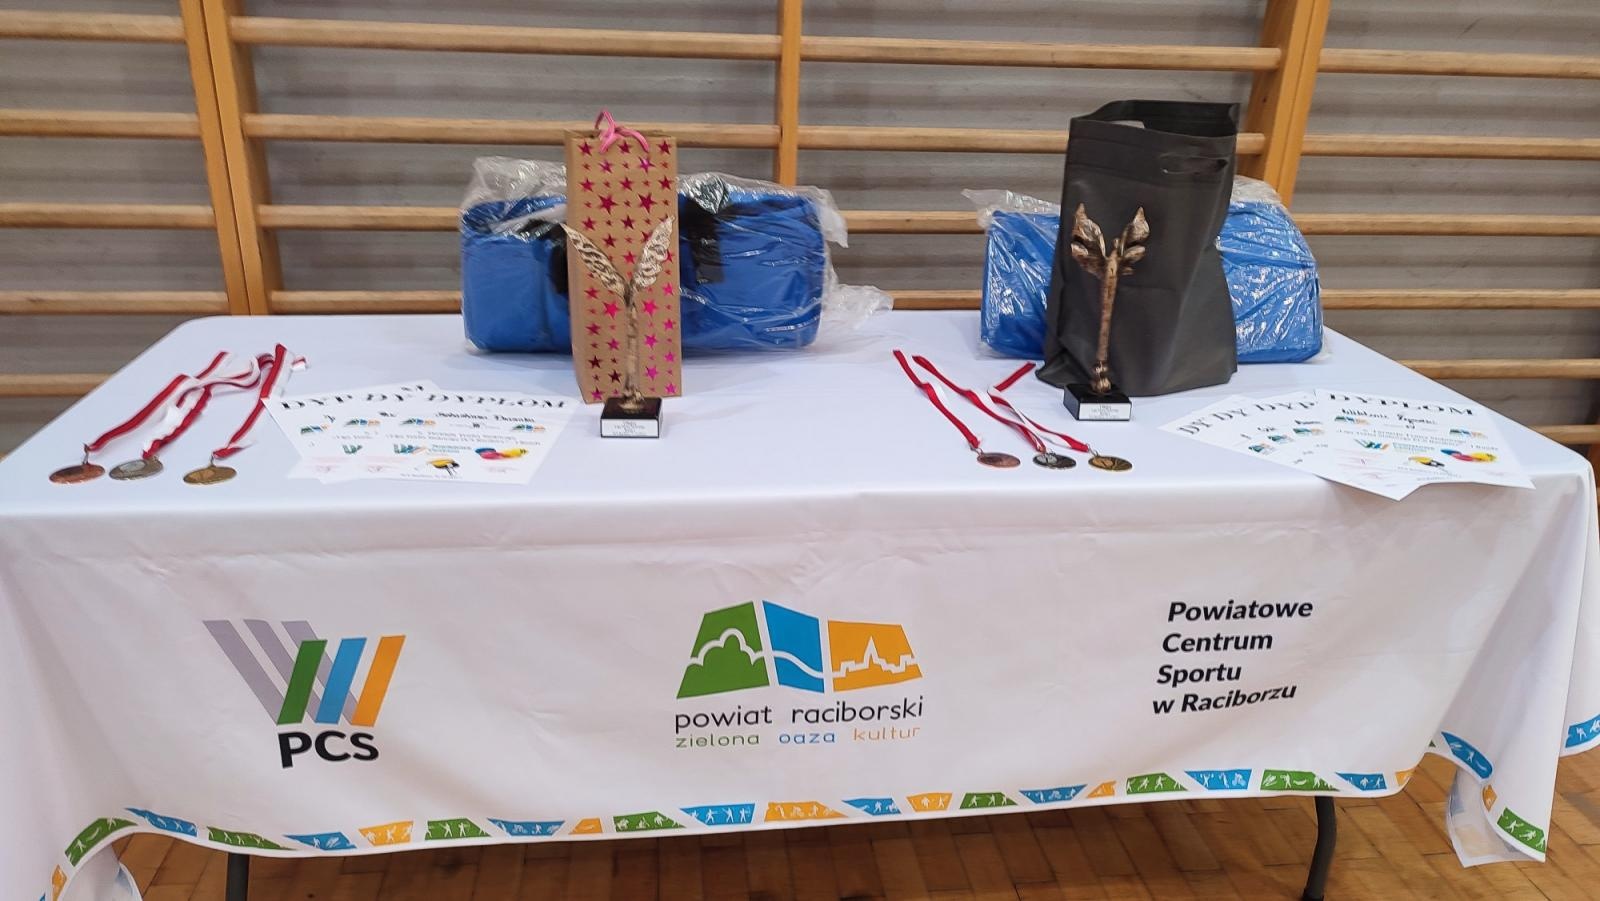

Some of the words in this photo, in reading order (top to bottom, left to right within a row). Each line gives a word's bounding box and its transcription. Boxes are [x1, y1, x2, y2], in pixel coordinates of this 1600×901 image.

[428, 394, 566, 409] DYPLOM
[1329, 393, 1475, 417] DYPLOM
[1168, 599, 1313, 622] Powiatowe
[1162, 632, 1273, 653] Centrum
[1156, 663, 1242, 688] Sportu
[1152, 699, 1175, 714] w
[1181, 685, 1297, 713] Raciborzu
[675, 705, 773, 734] powiat
[791, 695, 923, 724] raciborski
[277, 730, 379, 769] PCS
[676, 733, 760, 749] zielona
[779, 732, 836, 745] oaza
[853, 726, 921, 742] kultur
